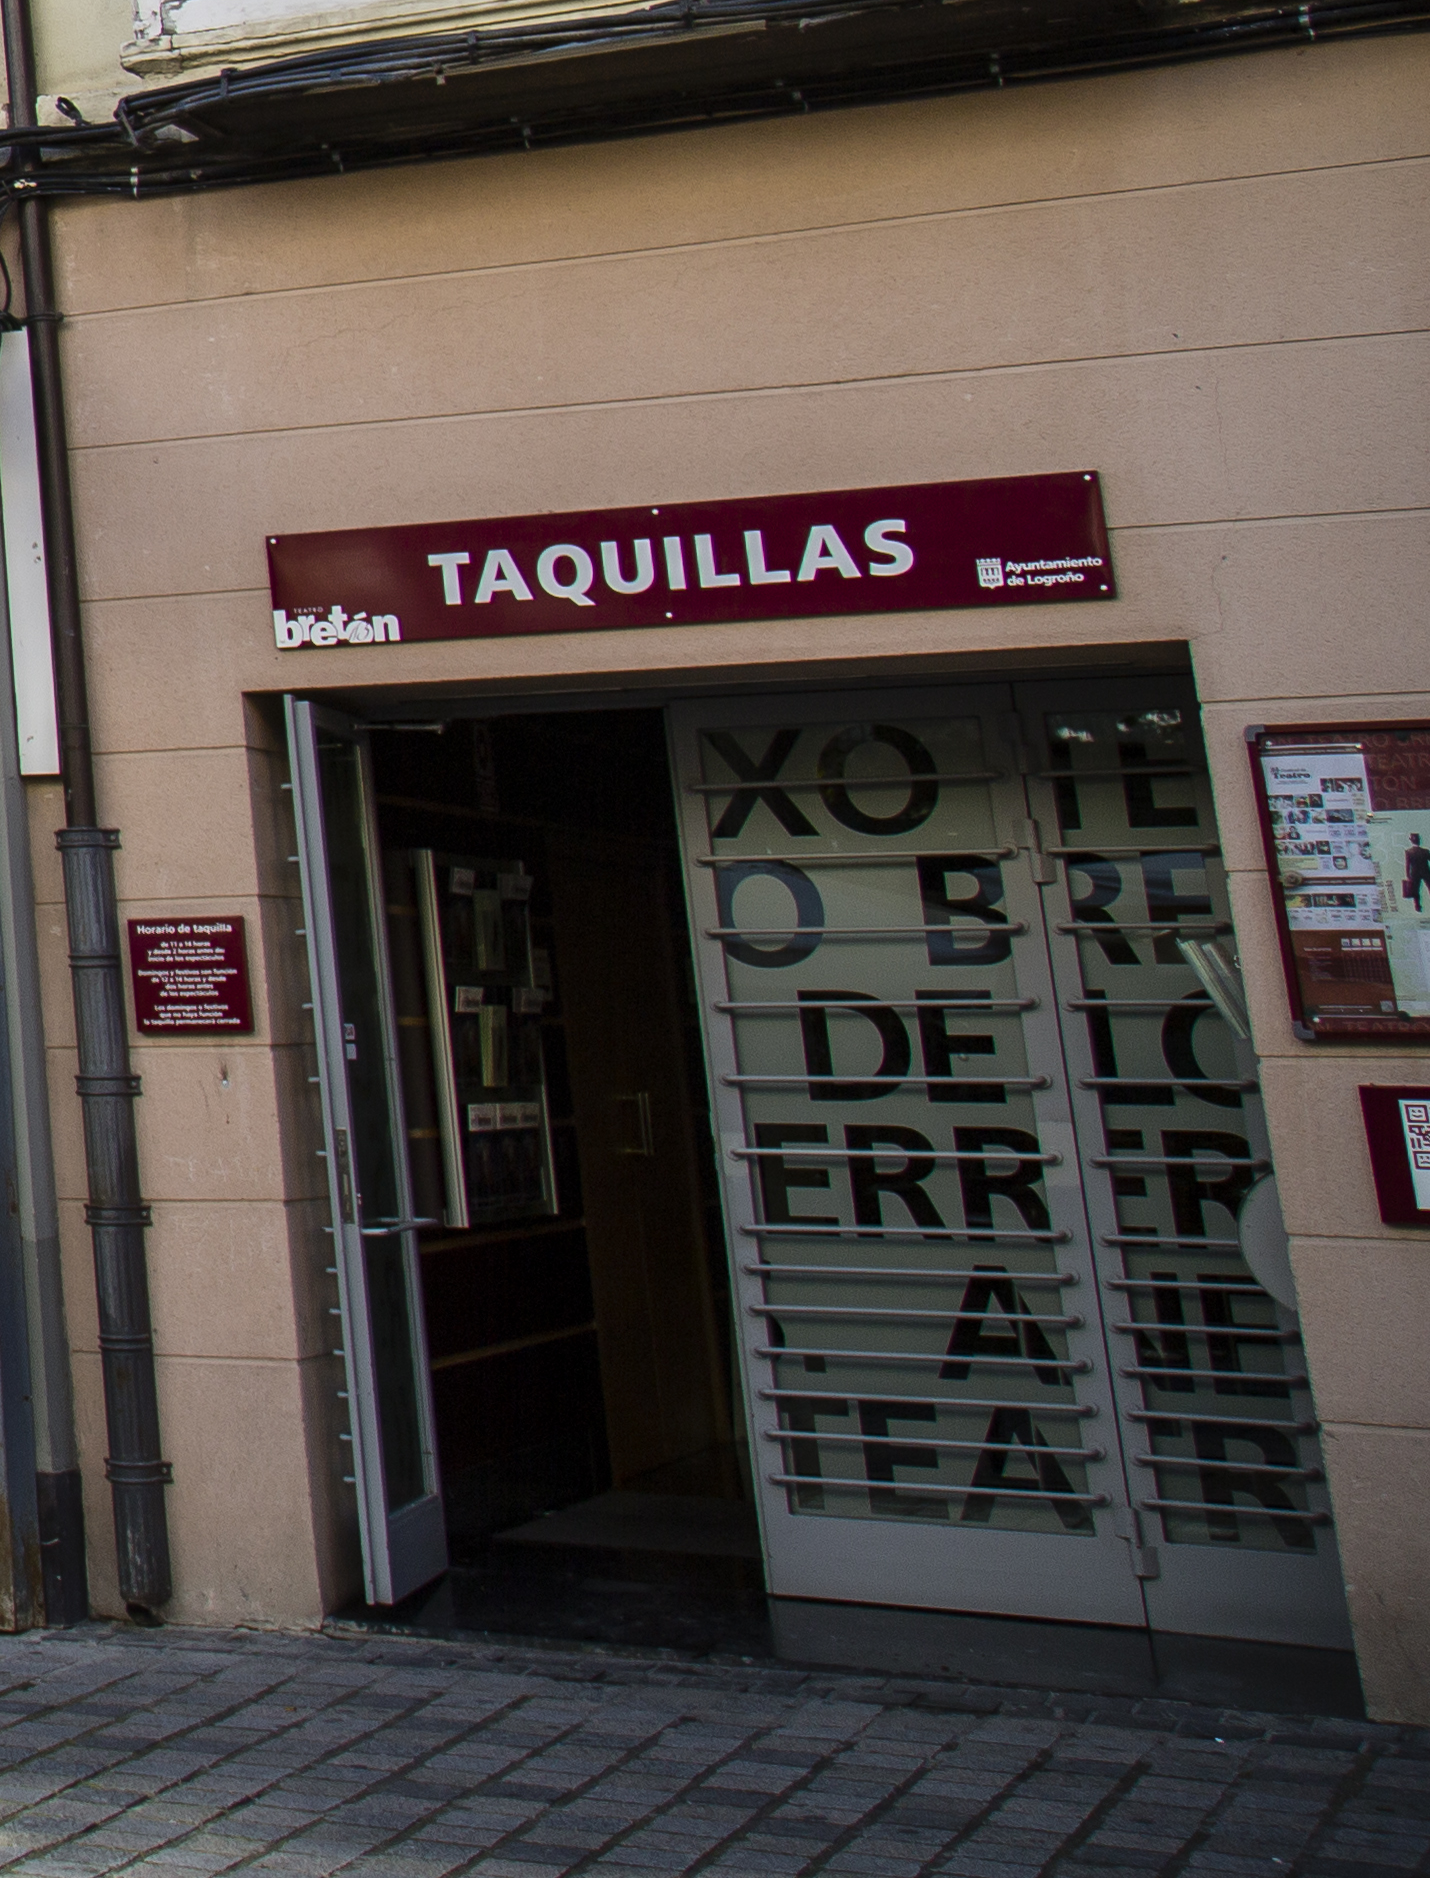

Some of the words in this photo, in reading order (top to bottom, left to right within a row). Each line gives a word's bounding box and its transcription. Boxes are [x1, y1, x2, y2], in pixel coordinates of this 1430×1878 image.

[427, 519, 914, 606] TAQUILLAS
[1005, 556, 1102, 574] Ayuntamiento
[1007, 575, 1025, 586] de
[1026, 571, 1084, 586] Logroño
[293, 606, 324, 614] TEATRO
[273, 605, 401, 648] bretón
[137, 923, 175, 934] Horario
[177, 923, 191, 934] de
[193, 922, 232, 935] taquilla
[797, 989, 1008, 1104] DE
